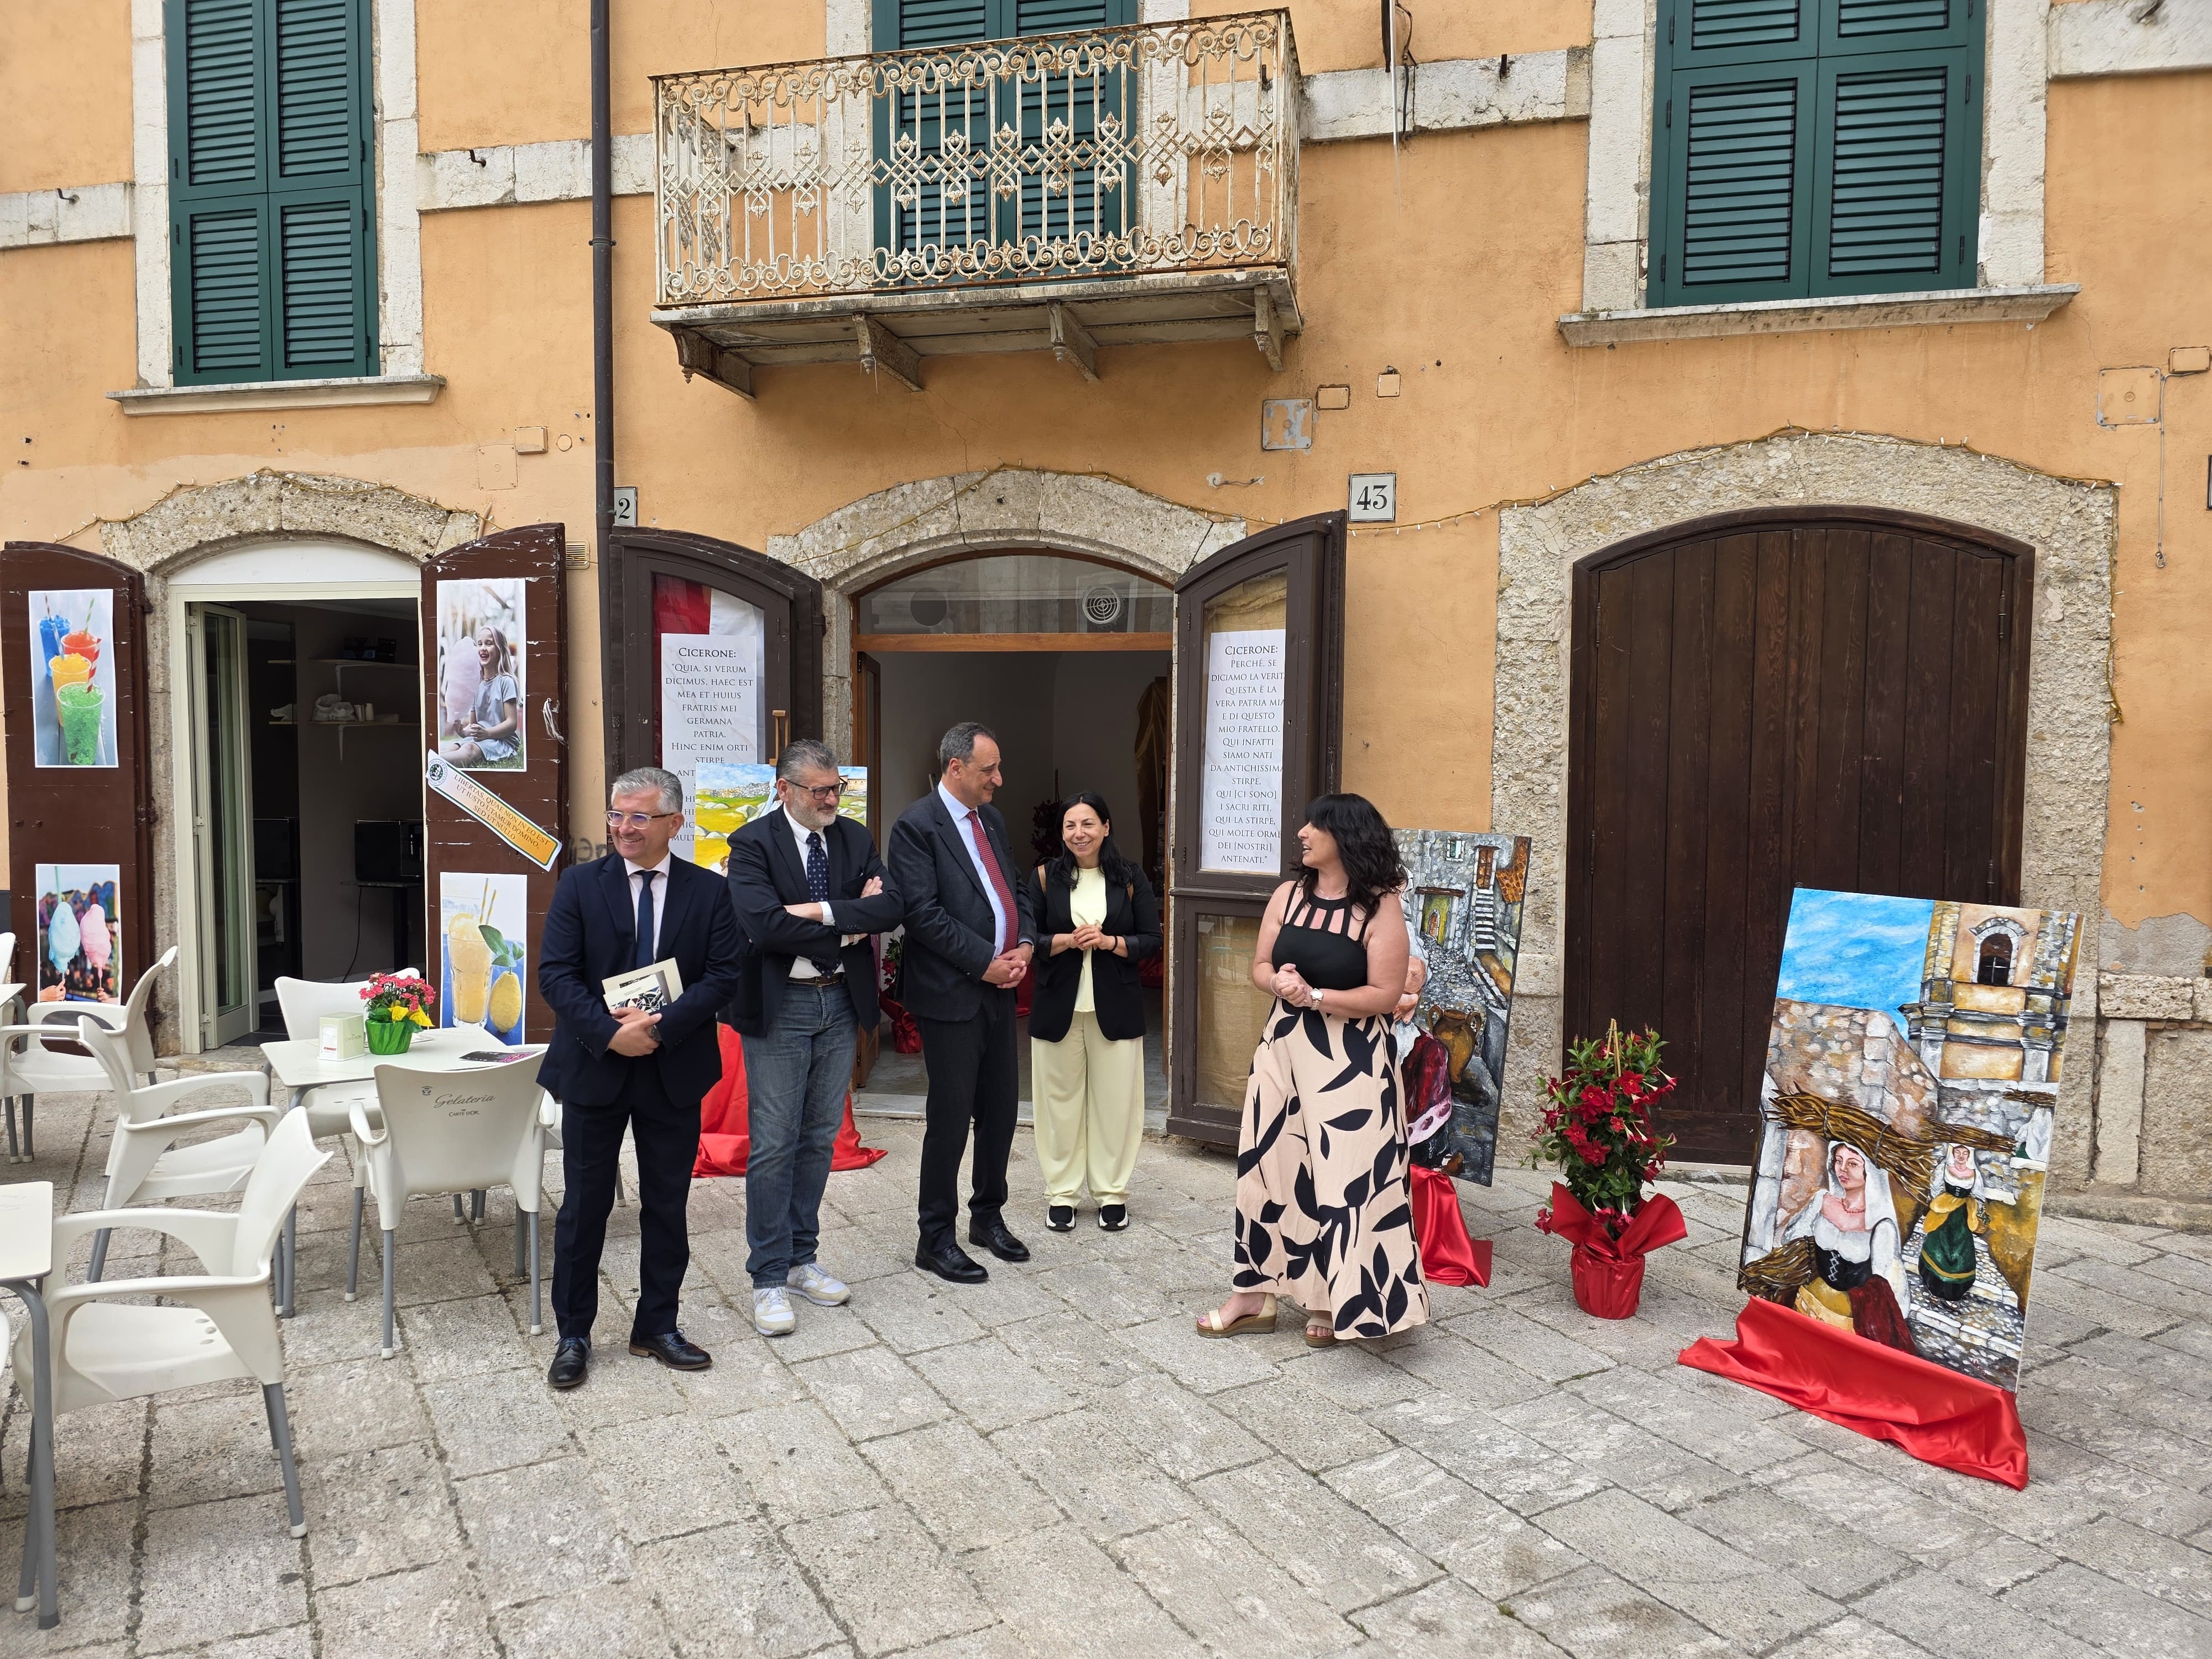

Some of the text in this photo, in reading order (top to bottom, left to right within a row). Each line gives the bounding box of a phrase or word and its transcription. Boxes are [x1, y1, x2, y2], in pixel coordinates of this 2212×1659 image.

[1357, 485, 1387, 510] 43
[614, 498, 630, 519] 2
[1231, 659, 1265, 668] PERCHÉ,
[666, 677, 708, 686] DICIMUS,
[1211, 673, 1247, 682] DICIAMO
[1261, 672, 1285, 680] VERIT
[1225, 686, 1256, 696] QUESTA
[1260, 684, 1264, 693] È
[1241, 712, 1275, 721] QUESTO
[671, 742, 697, 750] HINC
[1232, 778, 1261, 786] STIRPE,
[1216, 790, 1277, 800] QUI [CI SONO]
[454, 774, 484, 800] LIBERTAS,
[486, 797, 504, 812] QUAE
[504, 810, 519, 823] NON
[526, 827, 536, 836] EO
[536, 834, 550, 845] EST
[1253, 804, 1271, 812] RITI,
[456, 784, 539, 849] UT IUSTO UTAMUR DOMINO,
[1215, 816, 1230, 825] QUI
[1246, 817, 1276, 826] STIRPE,
[473, 805, 515, 839] SED UT NULLO
[1209, 828, 1224, 837] QUI
[1234, 842, 1272, 852] [NOSTRI]
[434, 1094, 495, 1108] Gelateria
